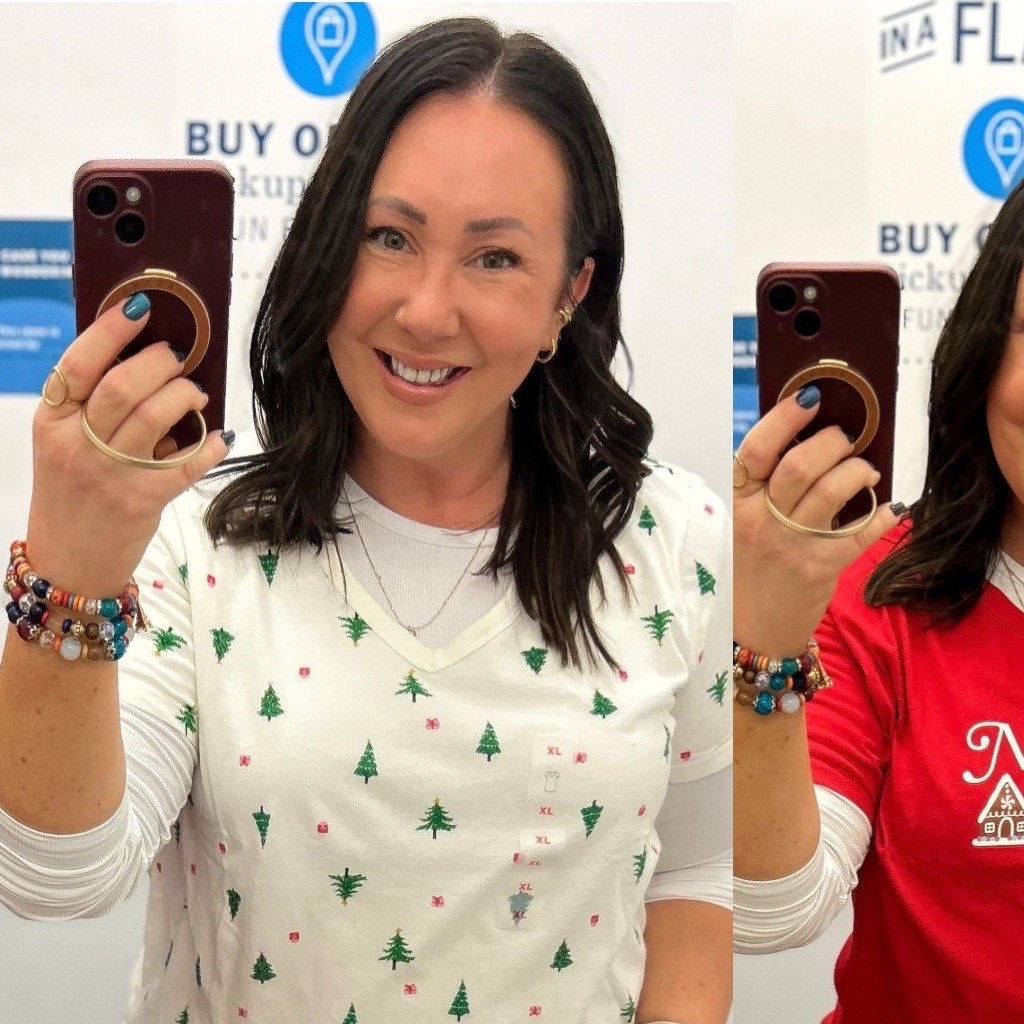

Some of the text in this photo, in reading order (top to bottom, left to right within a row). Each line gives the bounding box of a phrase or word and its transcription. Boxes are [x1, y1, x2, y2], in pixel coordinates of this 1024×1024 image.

[880, 22, 910, 60] IN
[916, 15, 936, 47] A
[187, 121, 274, 156] BUY
[238, 164, 306, 206] kup
[880, 223, 958, 254] BUY
[900, 262, 967, 293] icku
[546, 746, 562, 756] XL
[538, 806, 554, 816] XL
[536, 835, 551, 845] XL
[519, 882, 533, 891] XL
